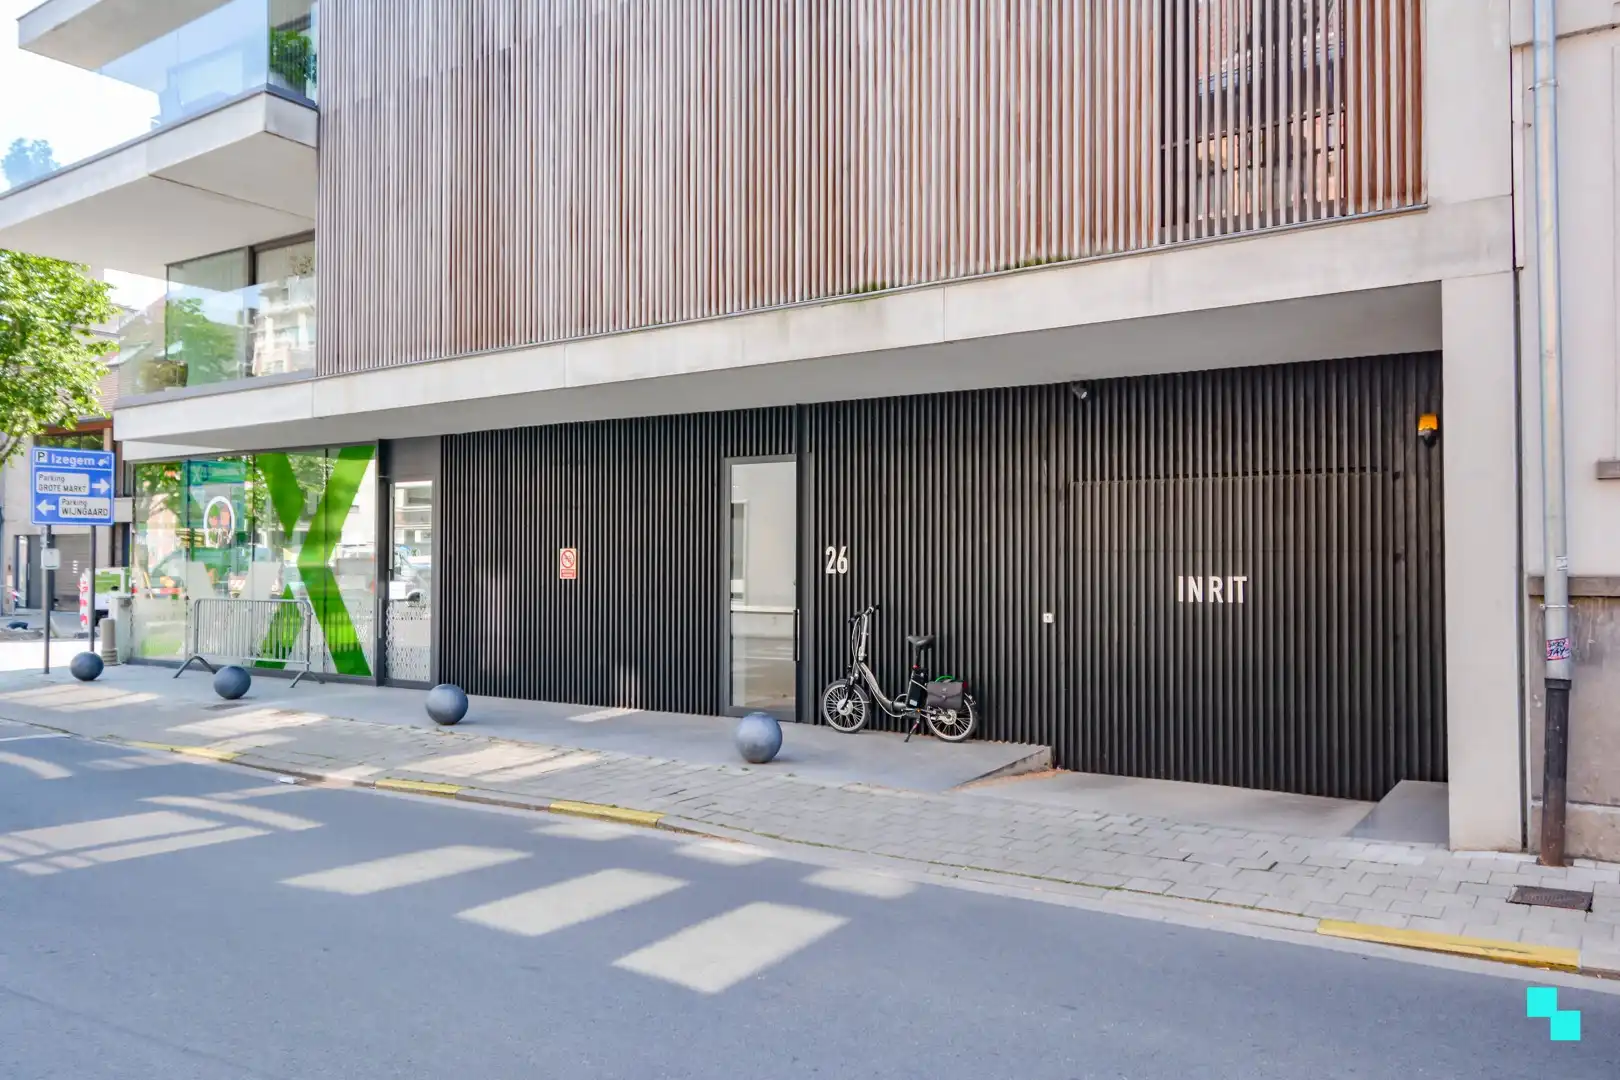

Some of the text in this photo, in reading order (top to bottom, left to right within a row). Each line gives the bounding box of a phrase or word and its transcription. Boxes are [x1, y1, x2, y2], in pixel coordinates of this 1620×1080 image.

[37, 451, 95, 467] P Izegem
[38, 474, 65, 483] Parking
[38, 484, 87, 493] GROTE MARKT
[61, 498, 88, 507] Parking
[61, 507, 109, 517] WIJNGAARD
[825, 546, 848, 574] 26
[1178, 575, 1248, 604] INRIT
